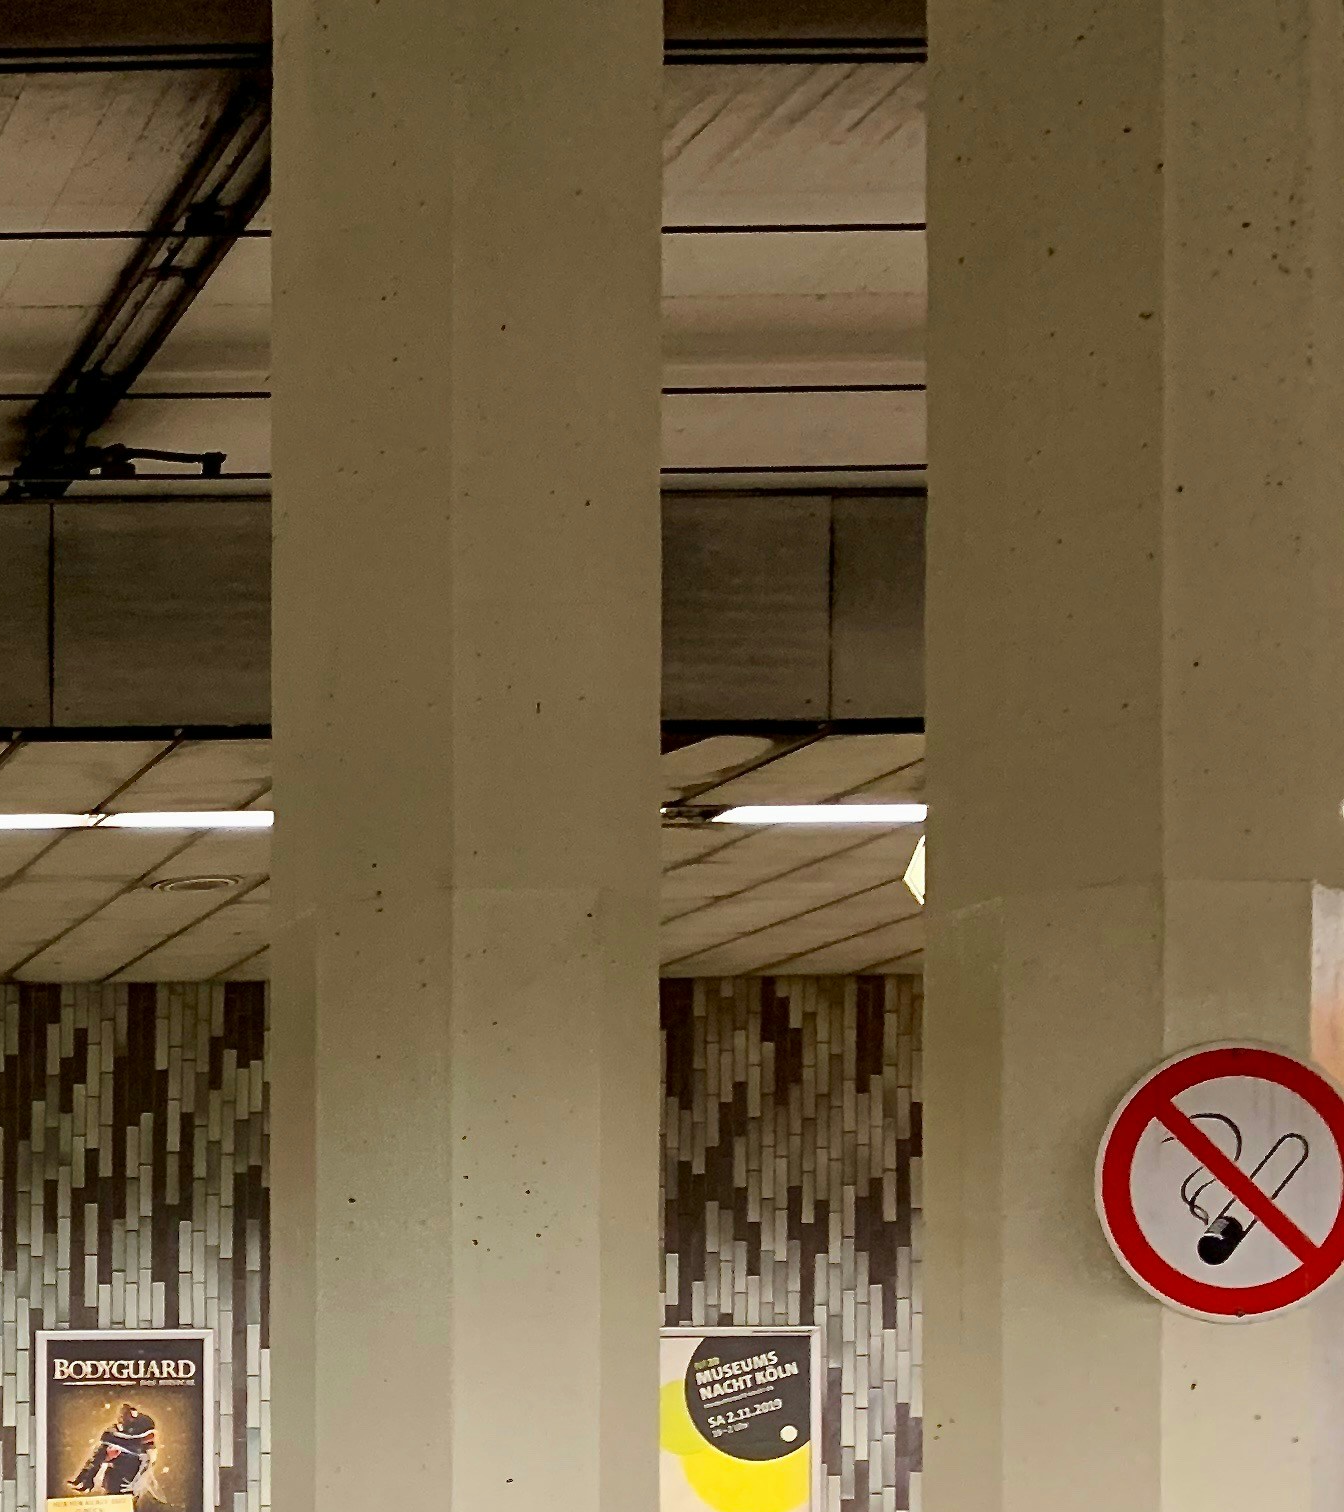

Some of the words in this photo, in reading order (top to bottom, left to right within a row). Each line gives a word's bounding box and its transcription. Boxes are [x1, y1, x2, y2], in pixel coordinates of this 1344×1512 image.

[53, 1359, 196, 1380] BODYGUARD
[695, 1351, 779, 1385] MUSEUMS
[699, 1375, 753, 1400] NACHT
[755, 1361, 799, 1385] KÖLN
[707, 1415, 726, 1428] SA
[726, 1399, 783, 1423] 2.11.2019
